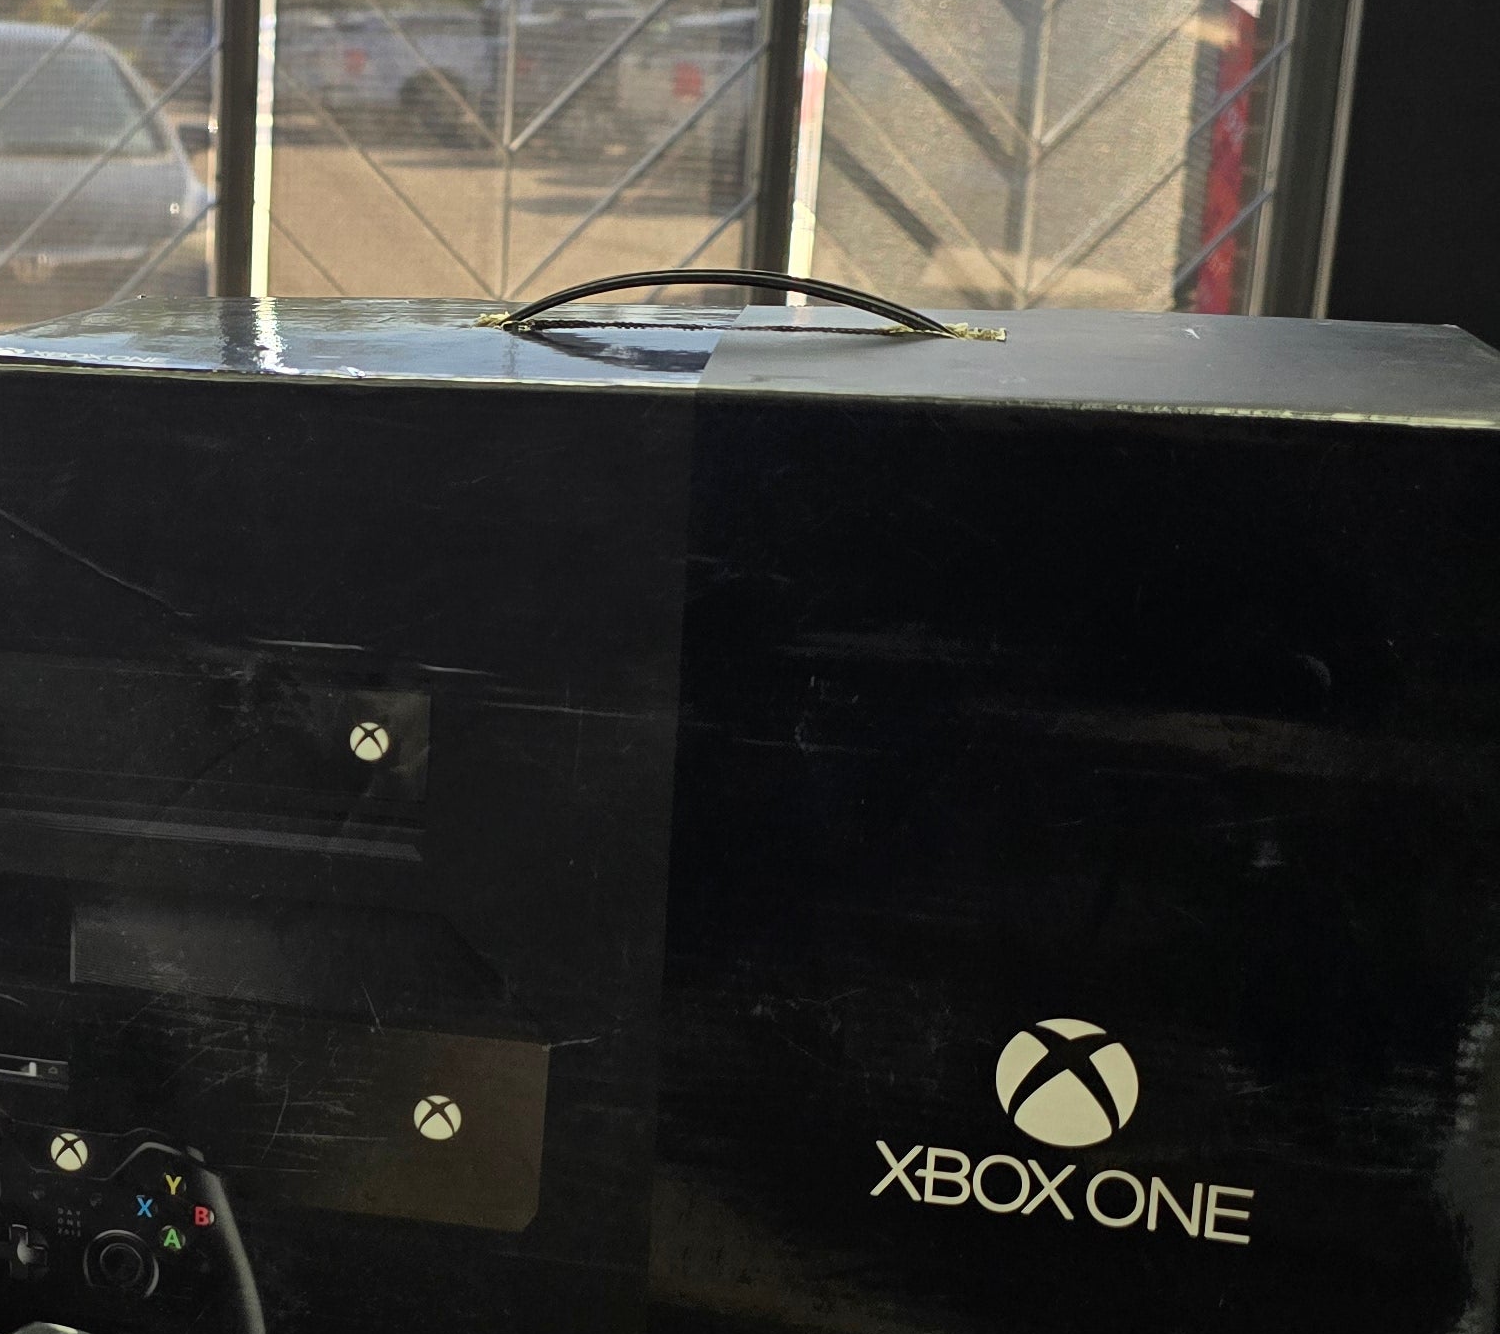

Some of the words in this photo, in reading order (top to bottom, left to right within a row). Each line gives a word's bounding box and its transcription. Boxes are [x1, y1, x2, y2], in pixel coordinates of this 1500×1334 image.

[165, 1175, 182, 1195] Y
[870, 1140, 1076, 1221] XBOX
[1086, 1169, 1254, 1245] ONE
[136, 1196, 153, 1217] X
[194, 1206, 210, 1226] B
[163, 1229, 182, 1250] A
